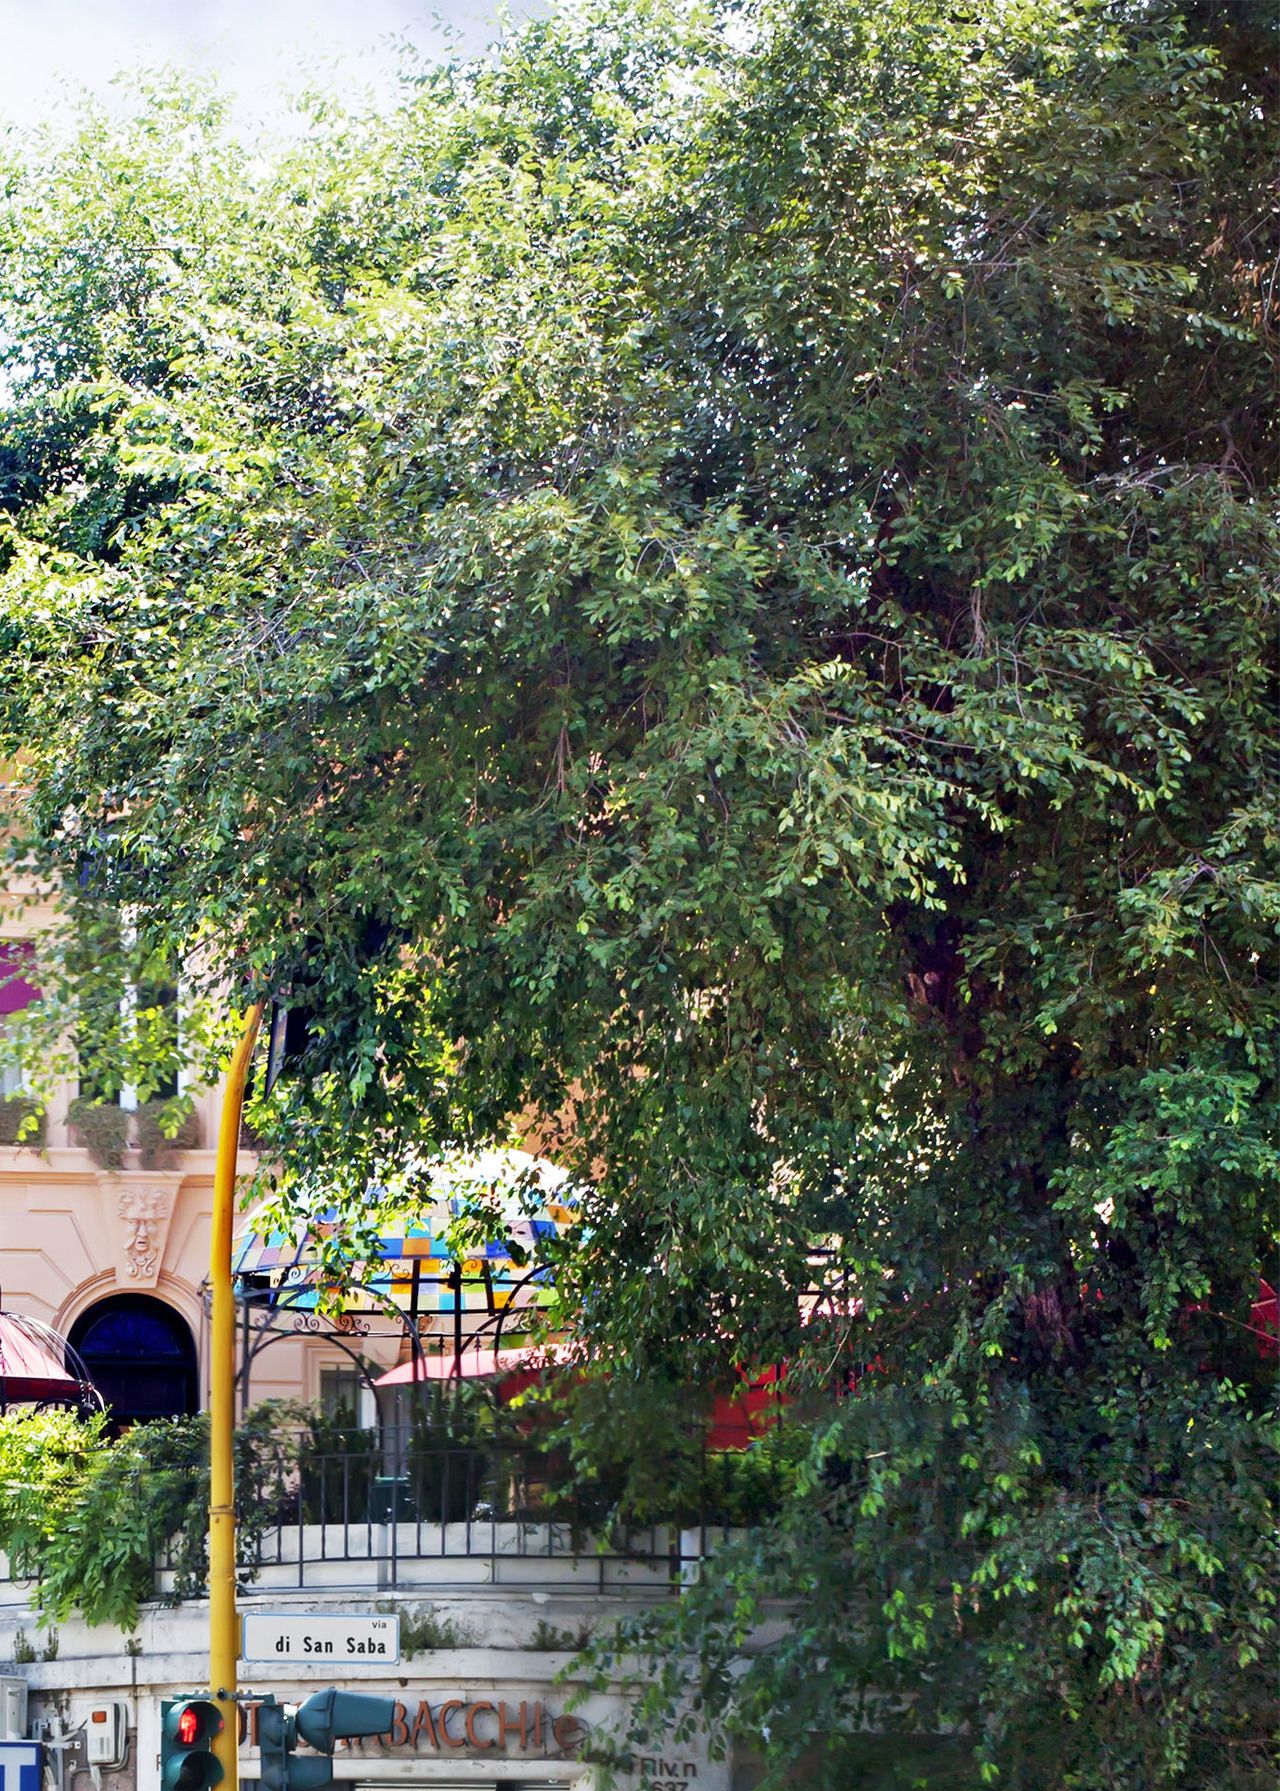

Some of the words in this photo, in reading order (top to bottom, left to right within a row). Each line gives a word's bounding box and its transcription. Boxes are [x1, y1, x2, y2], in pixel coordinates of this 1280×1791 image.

[372, 1621, 387, 1629] via
[276, 1636, 290, 1653] di
[303, 1636, 333, 1653] San
[346, 1637, 386, 1654] Saba
